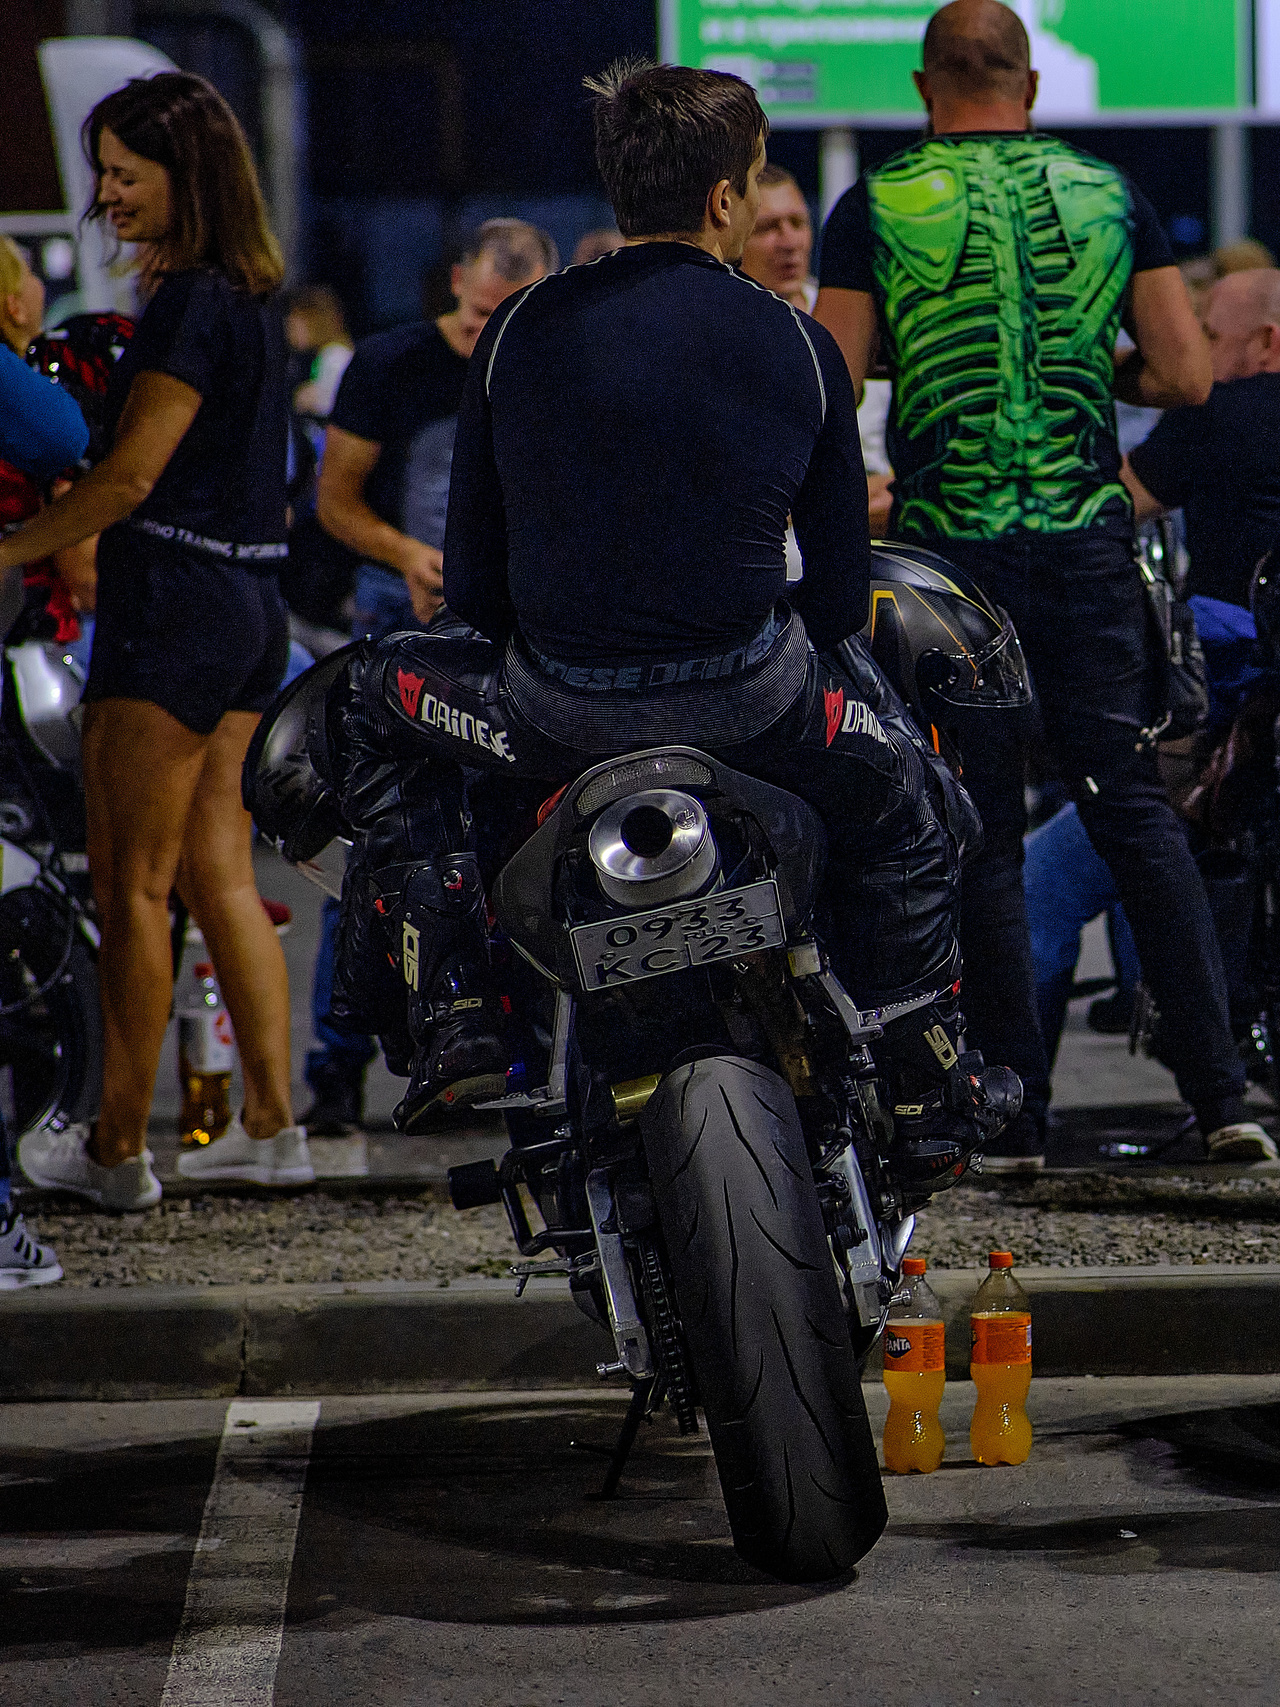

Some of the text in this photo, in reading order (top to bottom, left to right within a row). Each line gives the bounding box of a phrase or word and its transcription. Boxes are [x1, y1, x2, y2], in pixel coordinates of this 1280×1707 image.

[605, 895, 746, 948] 0933
[684, 921, 736, 942] RUS
[595, 923, 767, 985] KC 23
